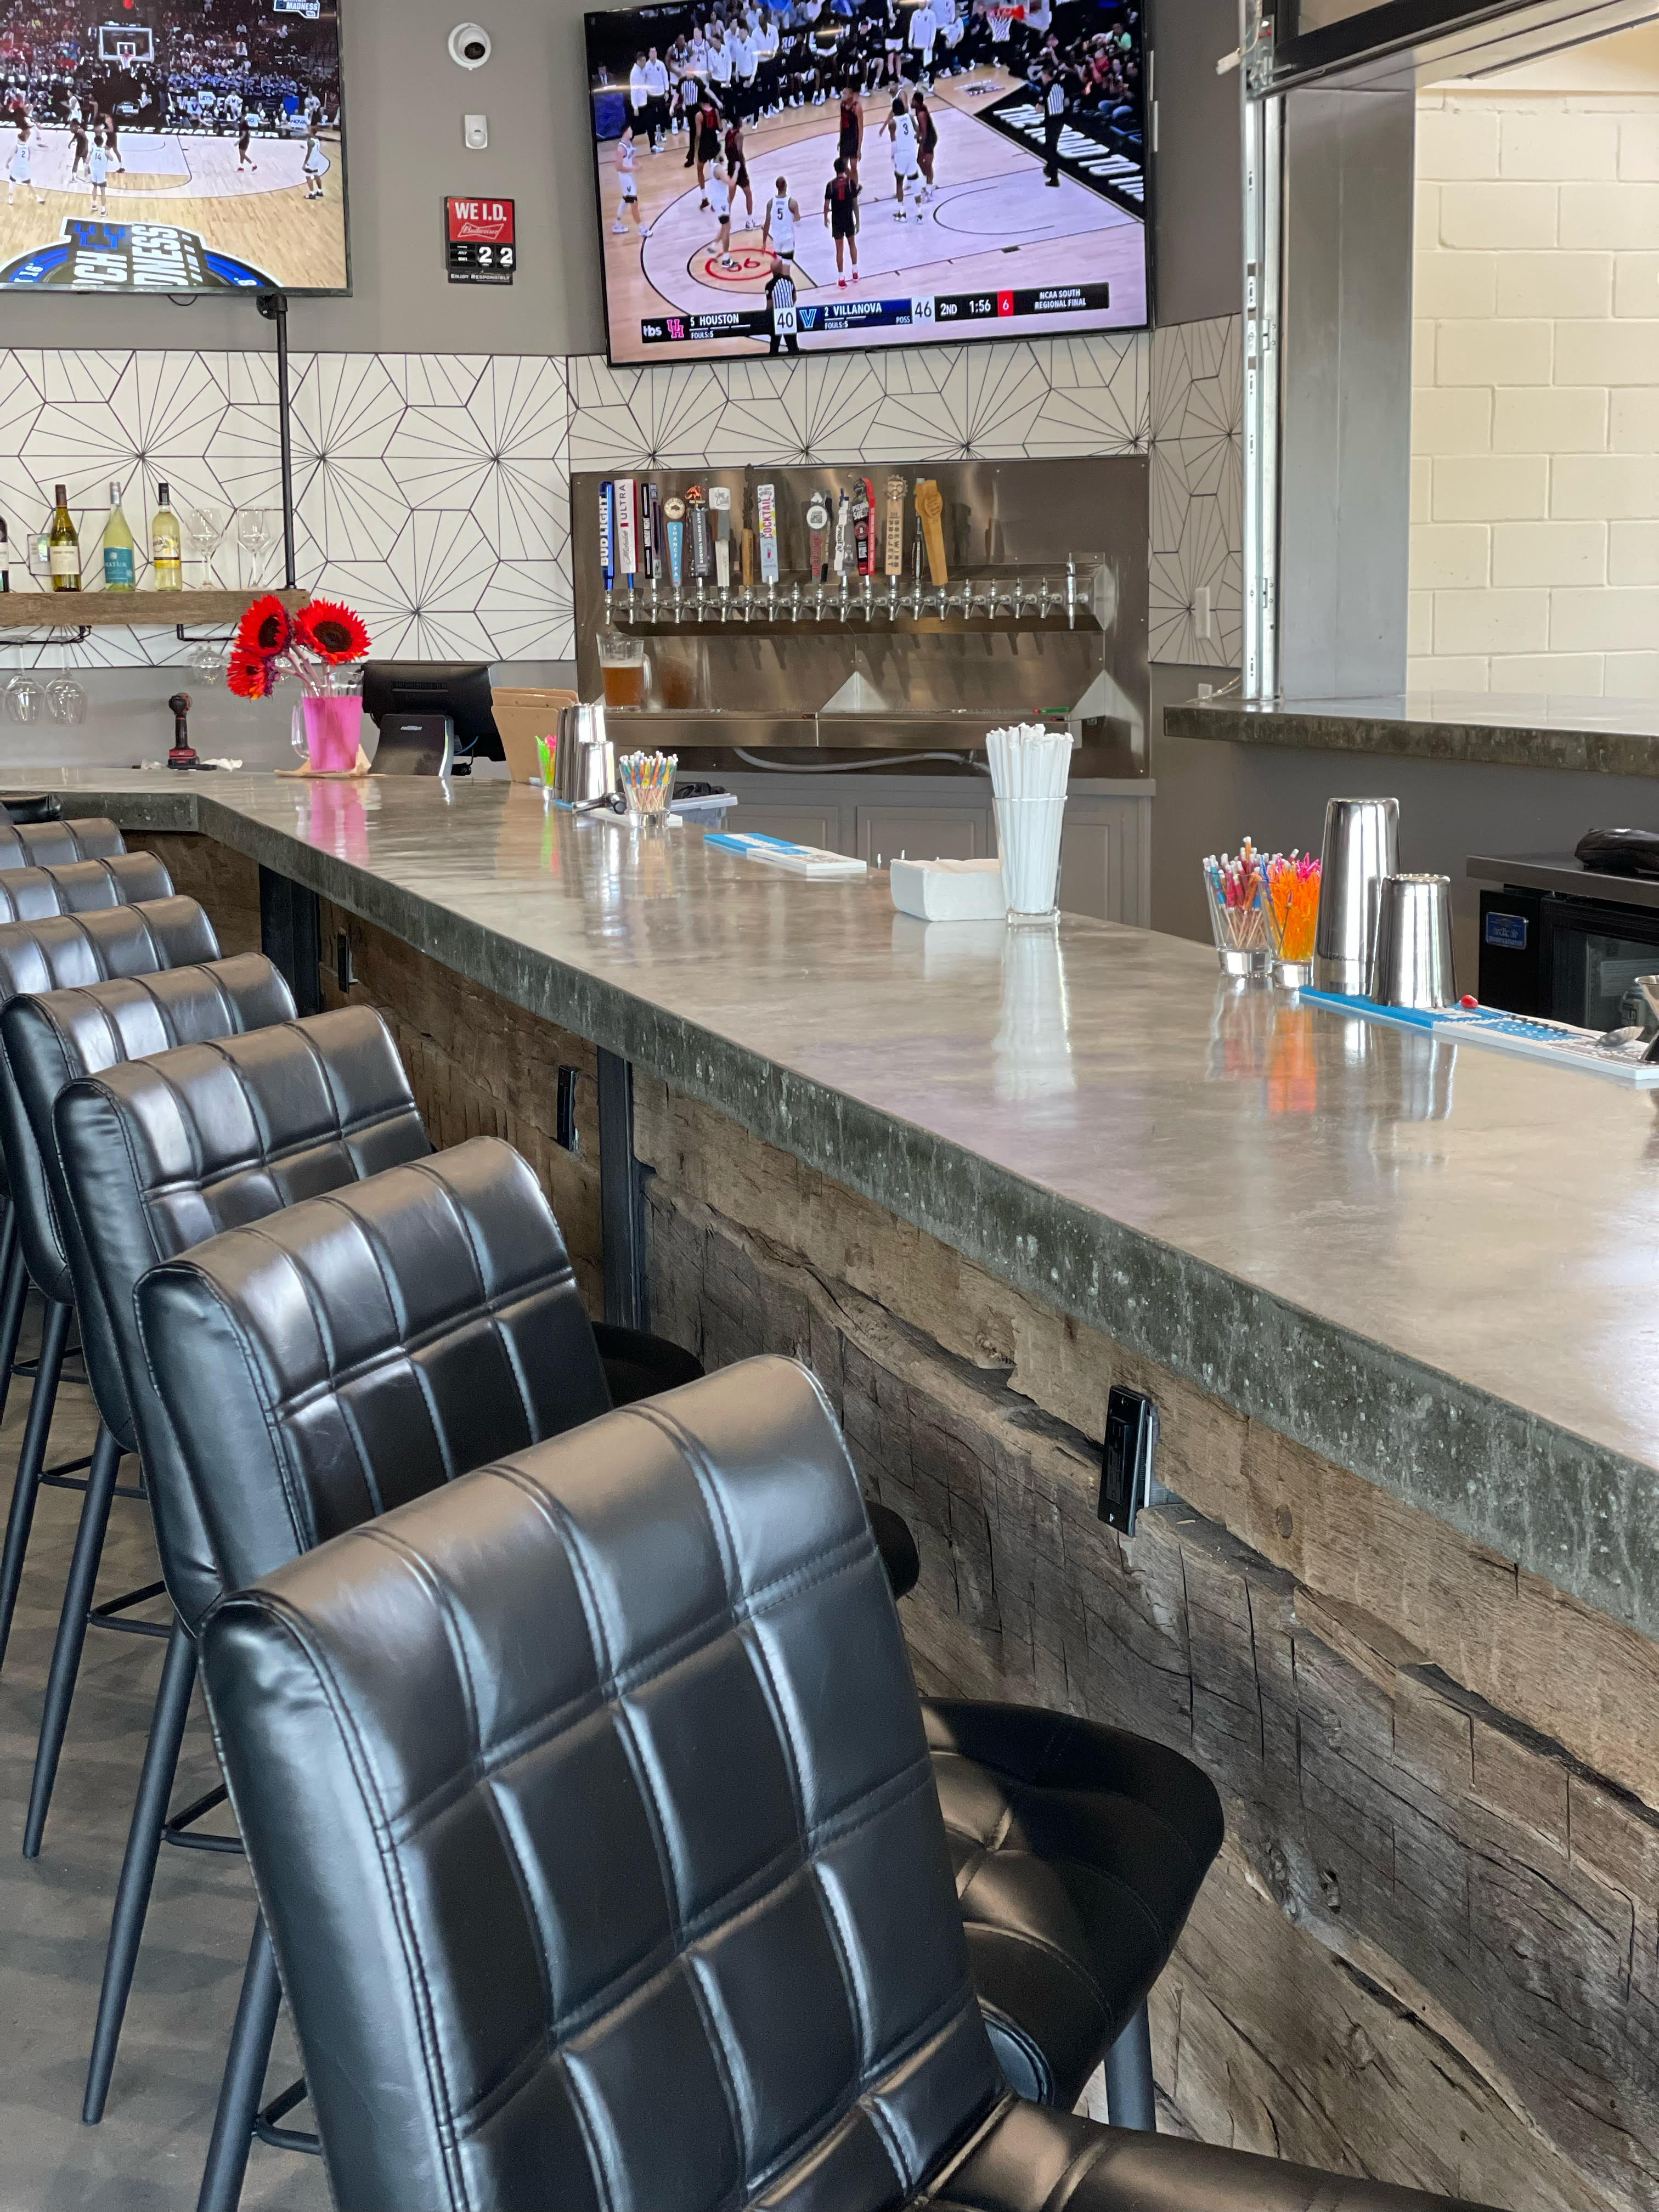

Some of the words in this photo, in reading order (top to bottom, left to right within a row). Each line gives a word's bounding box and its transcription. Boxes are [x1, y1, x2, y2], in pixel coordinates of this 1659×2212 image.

[902, 123, 909, 136] 3
[95, 153, 101, 161] 14
[455, 202, 479, 220] WE
[483, 203, 507, 221] I.D.
[777, 208, 783, 221] 5
[463, 225, 499, 235] Budweiser
[1039, 291, 1057, 300] NCAA
[1058, 289, 1081, 298] SOUTH
[824, 307, 830, 317] 2
[833, 302, 882, 317] VILLANOVA
[915, 301, 932, 318] 46
[940, 303, 957, 317] 2ND
[969, 300, 992, 314] 1:56
[1002, 300, 1009, 311] 6
[1034, 300, 1067, 310] REGIONAL
[1068, 297, 1087, 307] FINAL
[690, 317, 696, 327] 5
[699, 313, 740, 325] HOUSTON
[777, 312, 794, 329] 40
[825, 320, 848, 329] FOULS:5
[896, 316, 911, 324] POSS
[643, 325, 663, 337] tbs
[691, 331, 714, 340] FOULS:5
[619, 484, 628, 520] ULTRA
[599, 496, 608, 536] LIGHT
[762, 496, 774, 540] COCKTAIL
[600, 538, 608, 566] BUD
